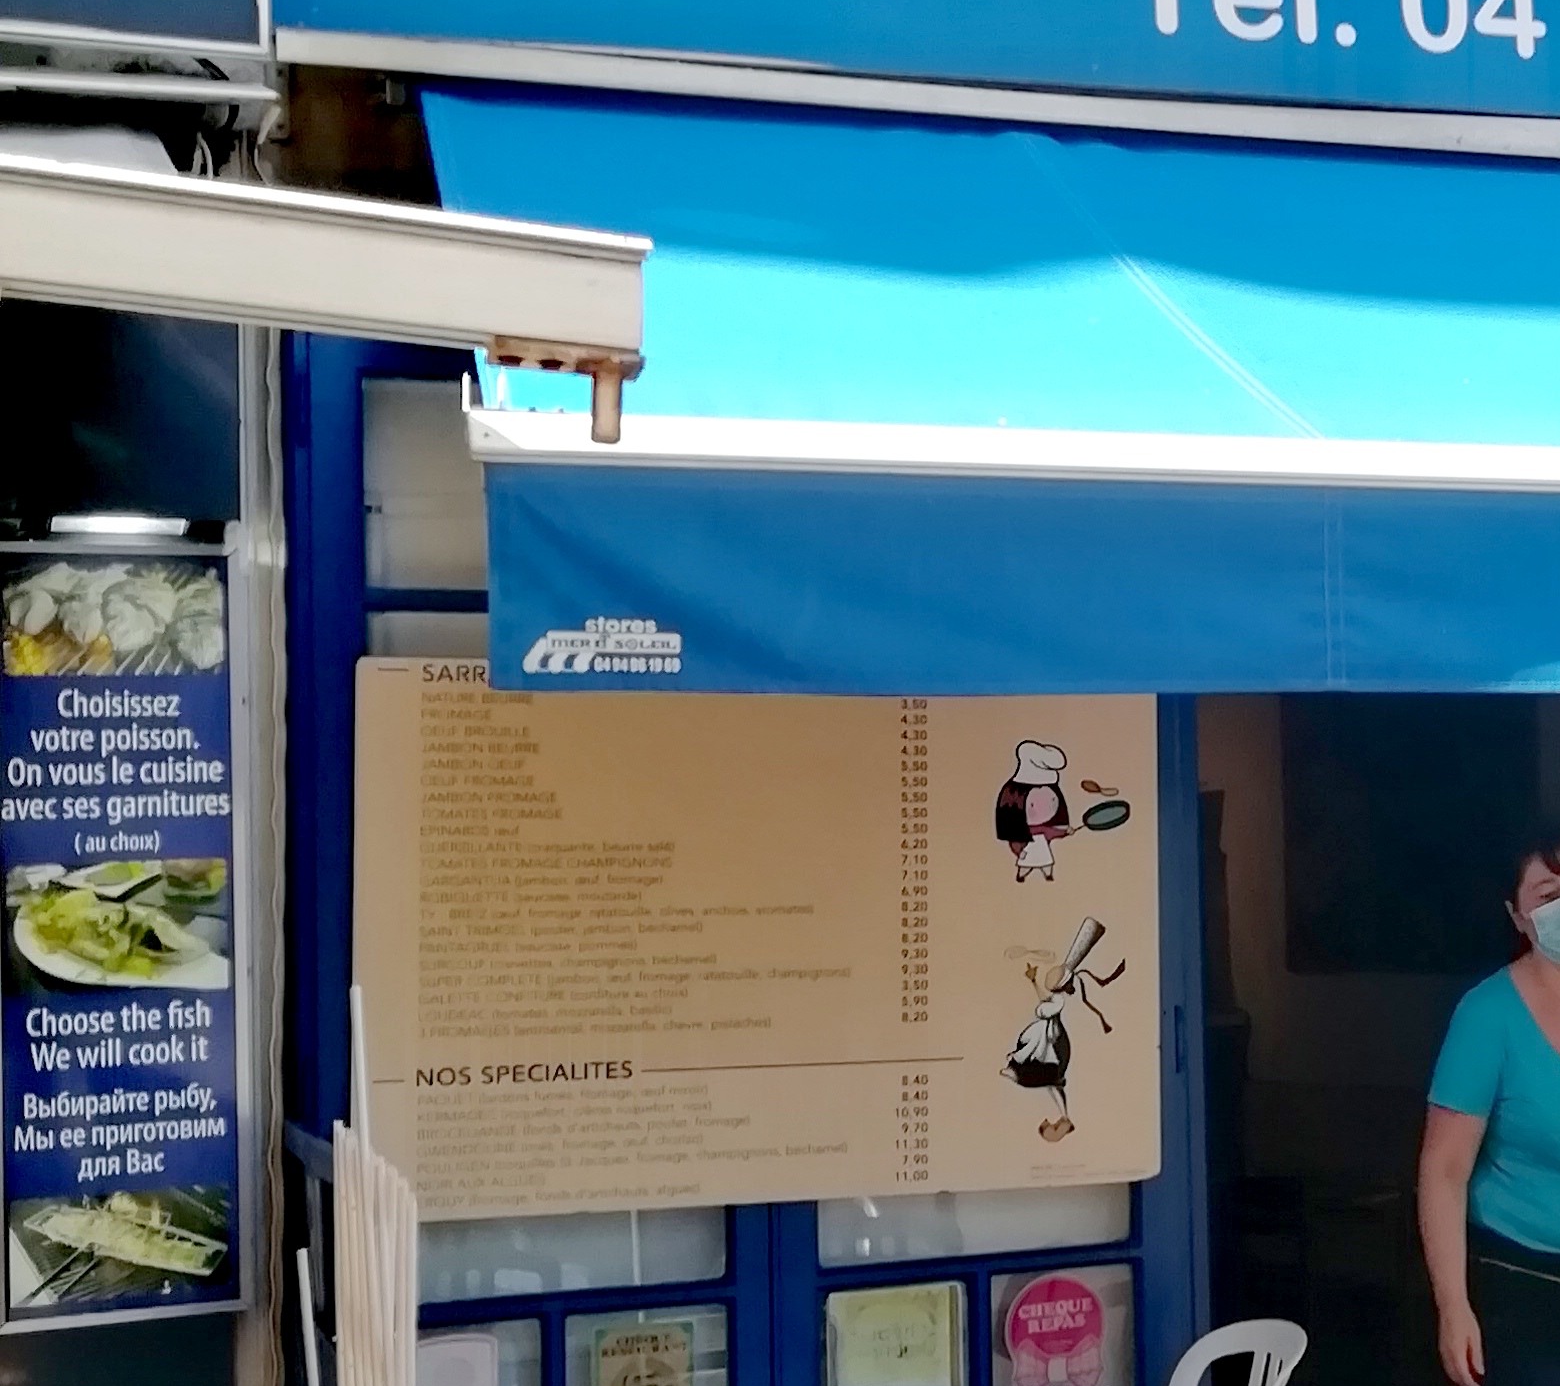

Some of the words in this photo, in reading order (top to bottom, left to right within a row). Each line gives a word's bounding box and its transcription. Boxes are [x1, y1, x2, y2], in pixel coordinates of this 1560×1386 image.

[58, 688, 181, 718] Choisissez
[30, 726, 95, 752] votre
[101, 722, 200, 757] poisson.
[8, 757, 42, 787] On
[49, 761, 106, 786] vous
[112, 756, 134, 784] le
[140, 755, 225, 783] cuisine
[1, 796, 57, 821] avec
[62, 795, 101, 819] ses
[107, 790, 231, 825] garnitures
[110, 829, 160, 853] choix)
[26, 1007, 115, 1037] Choose
[120, 1002, 162, 1032] the
[168, 998, 211, 1029] fish
[30, 1041, 71, 1072] We
[77, 1037, 121, 1069] will
[129, 1034, 185, 1065] cook
[190, 1034, 209, 1061] it
[415, 1066, 472, 1087] NOS
[481, 1060, 634, 1085] SPECIALITES
[23, 1088, 149, 1121] Выбирайте
[154, 1081, 218, 1116] рыбу,
[14, 1123, 54, 1152] Мы
[60, 1126, 86, 1148] ее
[91, 1116, 226, 1151] приготовим
[77, 1155, 120, 1182] для
[126, 1148, 165, 1176] Вас
[1018, 1297, 1095, 1319] CHEQUE
[1027, 1314, 1087, 1334] REPAS
